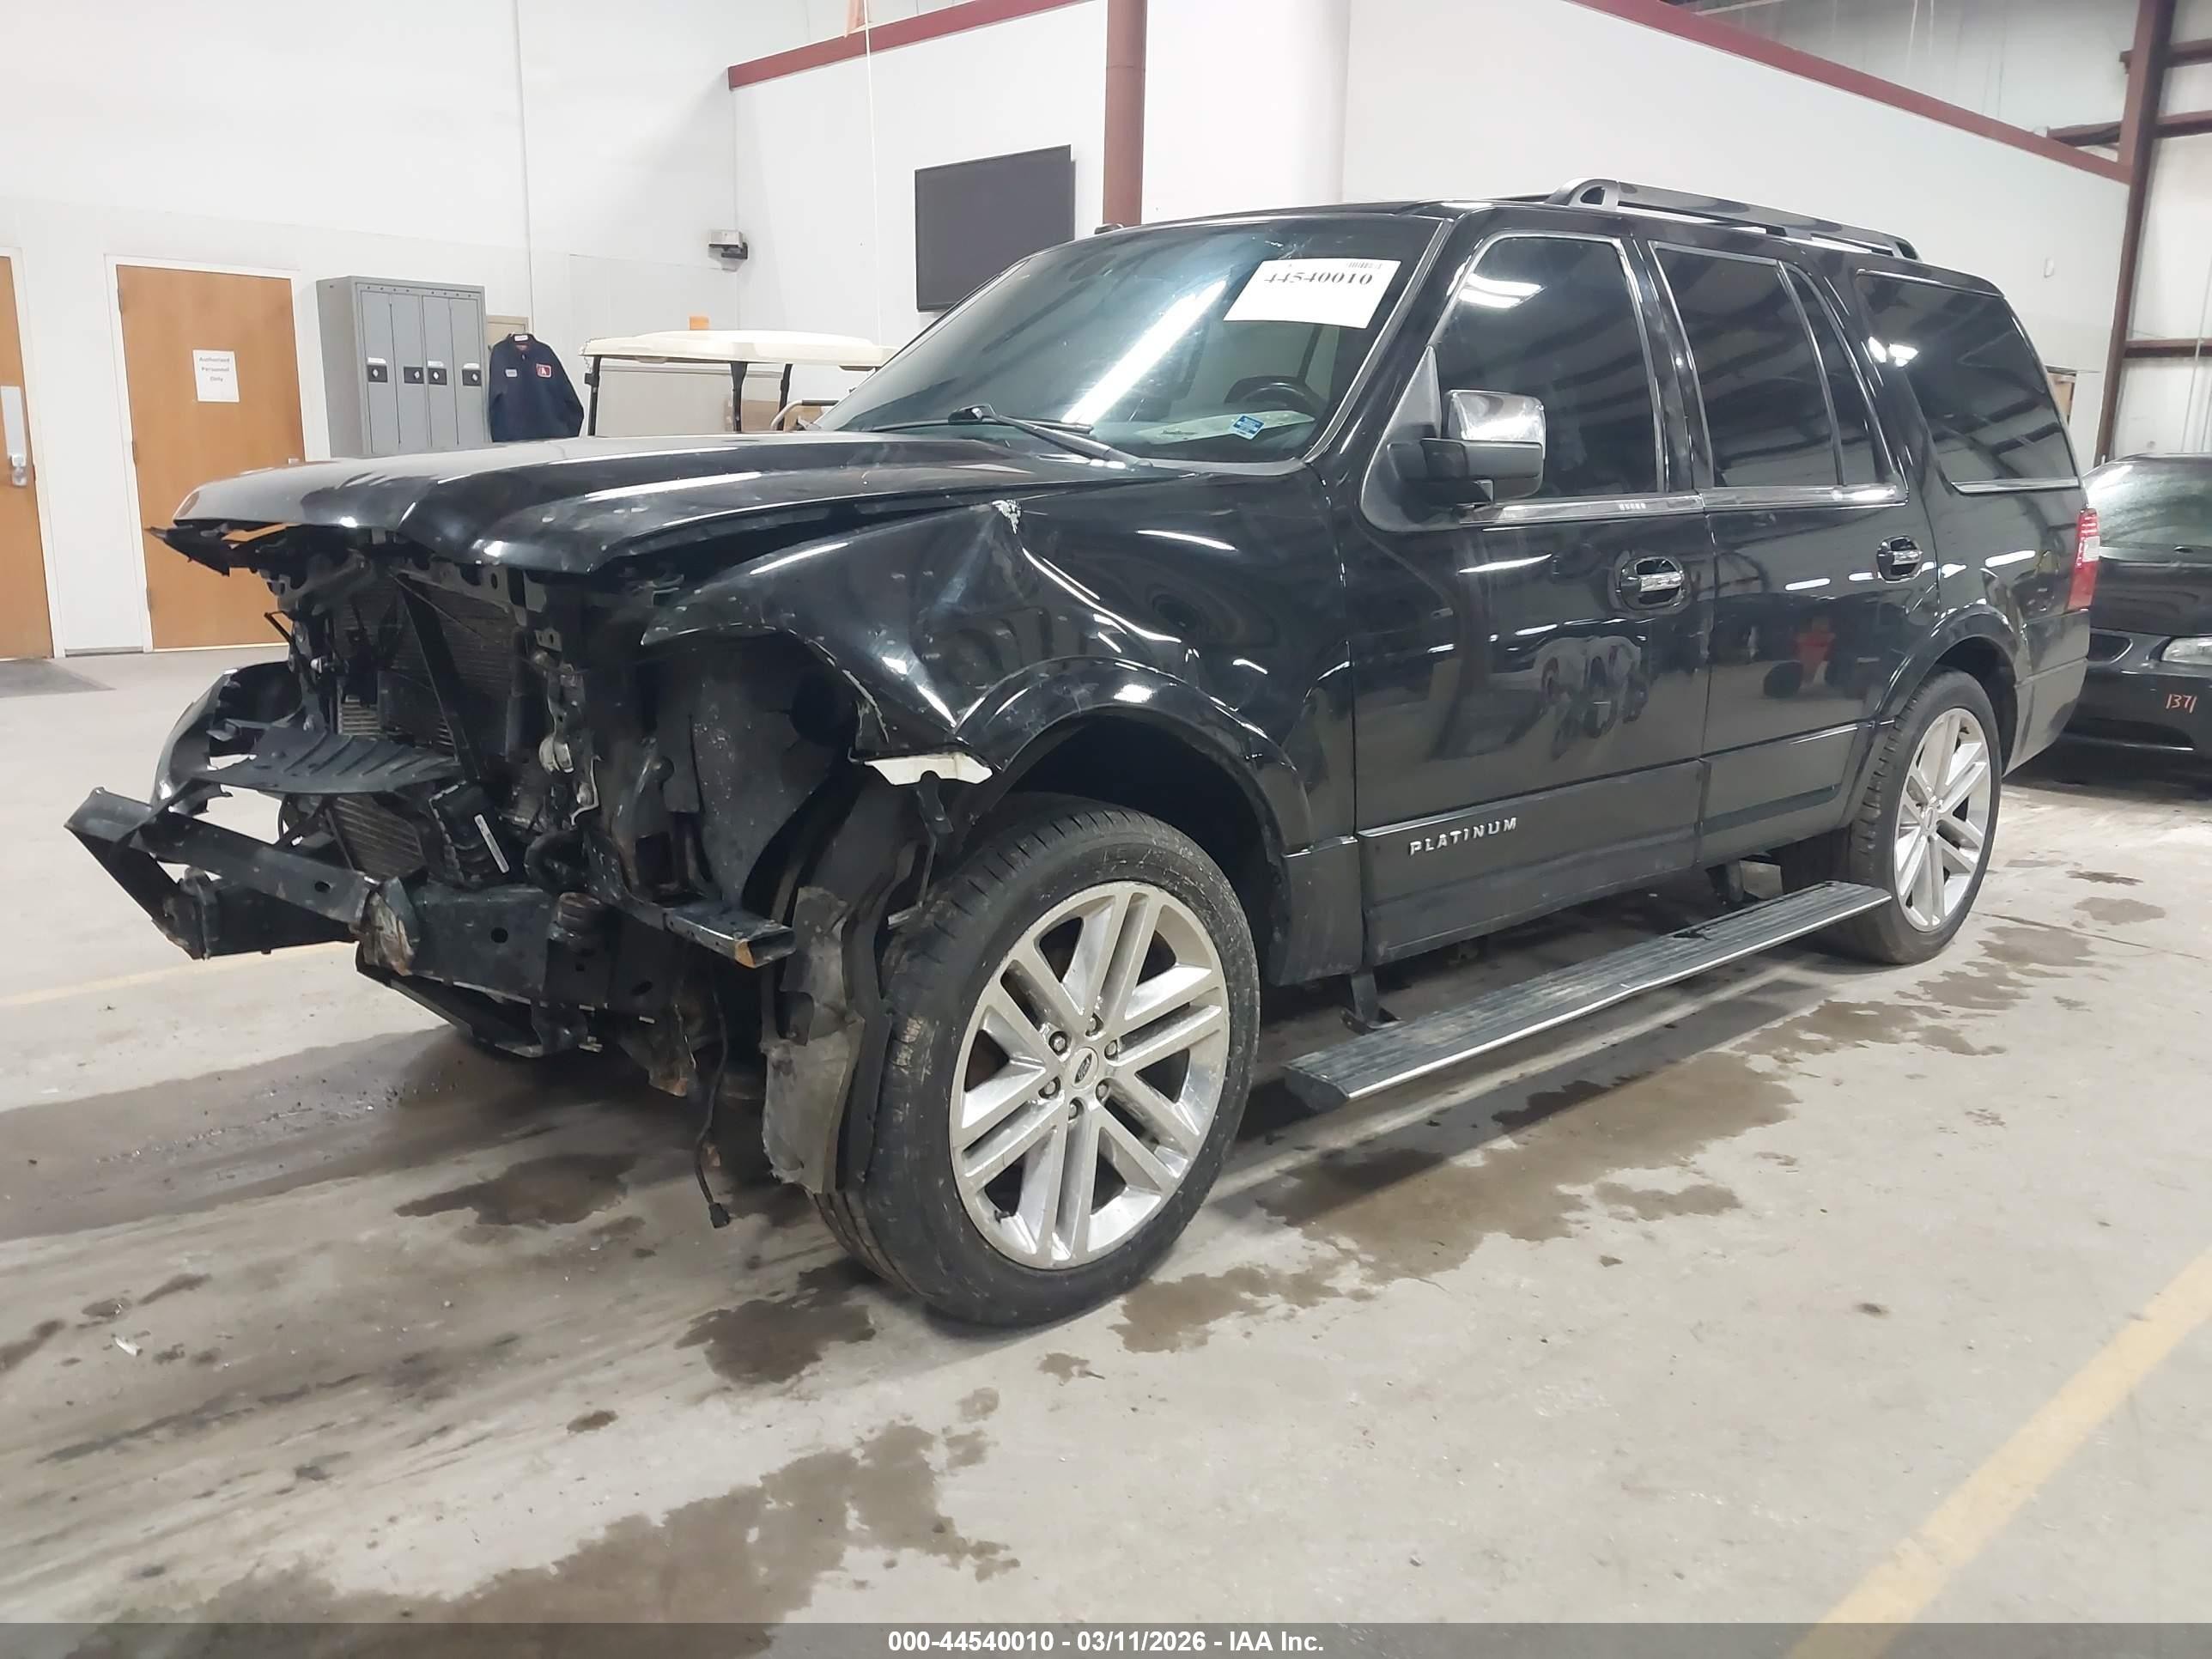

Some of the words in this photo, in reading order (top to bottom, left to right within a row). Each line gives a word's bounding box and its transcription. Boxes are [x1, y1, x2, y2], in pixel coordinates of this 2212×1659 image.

[1264, 271, 1373, 285] 44540010
[2165, 693, 2197, 714] 1371
[1409, 817, 1517, 856] PLATINUM
